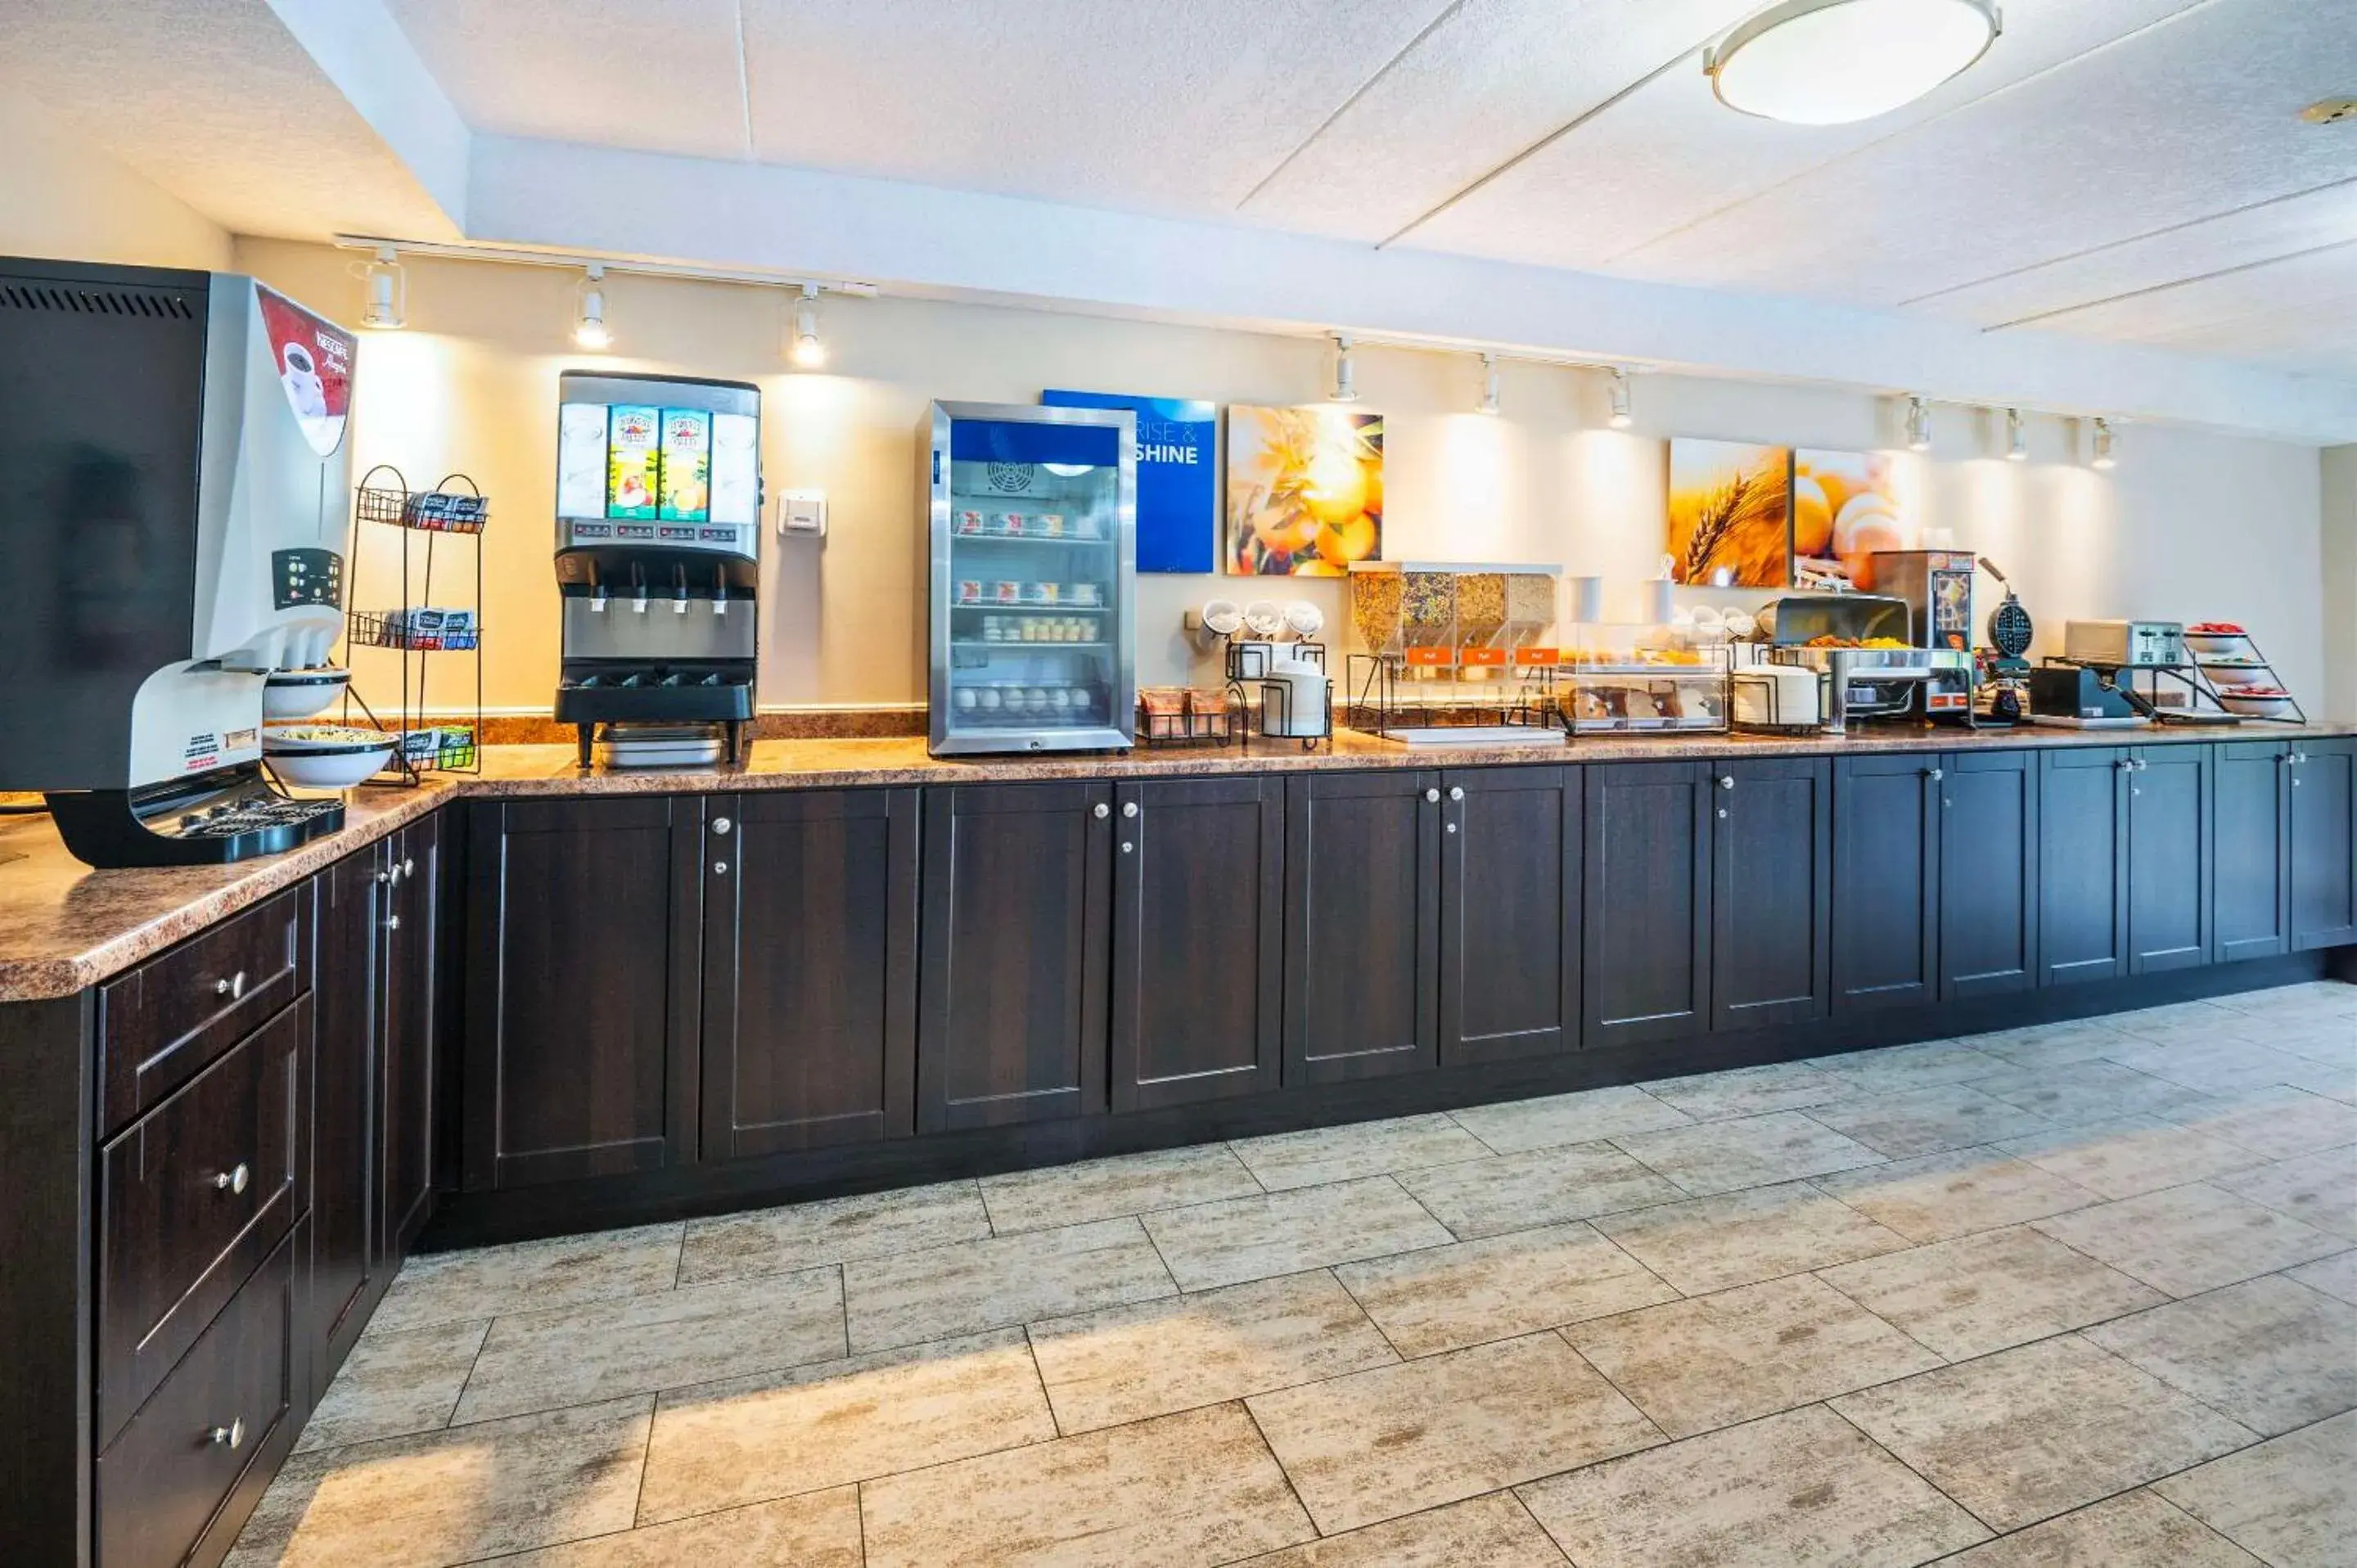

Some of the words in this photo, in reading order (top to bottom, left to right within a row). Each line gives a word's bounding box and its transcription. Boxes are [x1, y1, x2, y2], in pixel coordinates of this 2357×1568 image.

[1136, 419, 1176, 443] RISE
[1182, 423, 1197, 444] &
[1136, 443, 1198, 464] SHINE
